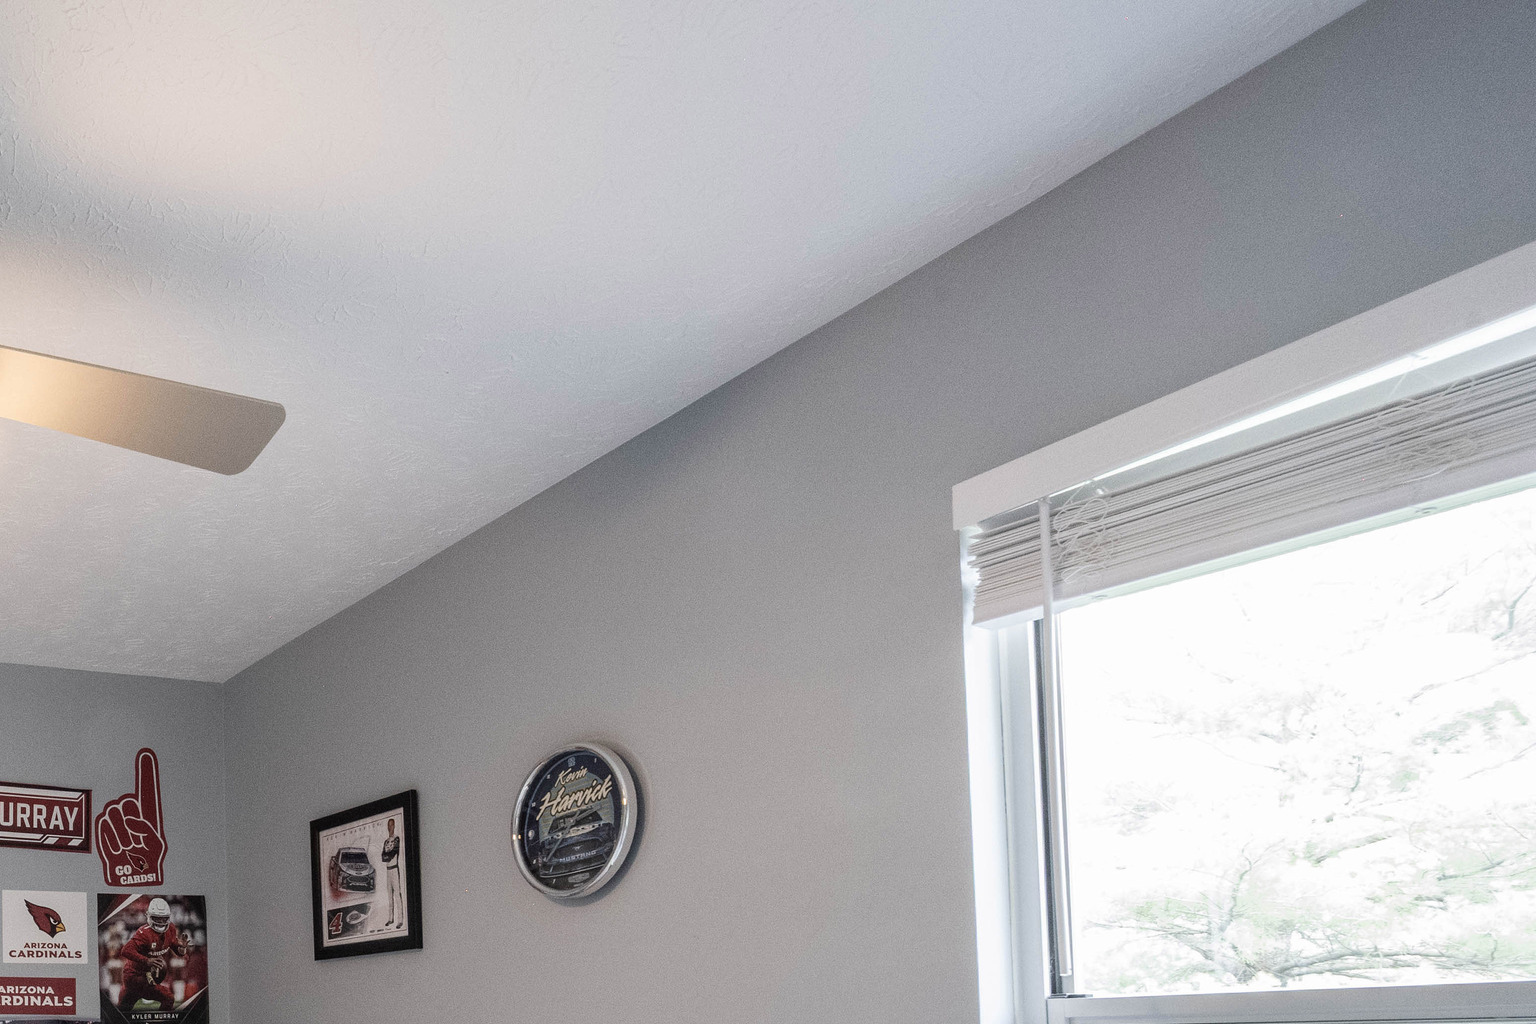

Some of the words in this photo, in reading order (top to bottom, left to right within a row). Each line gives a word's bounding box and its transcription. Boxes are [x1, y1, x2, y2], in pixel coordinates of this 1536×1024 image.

[536, 774, 613, 820] Harvick
[115, 865, 132, 876] GO
[120, 873, 157, 885] CARDS!
[329, 912, 343, 935] 4
[9, 950, 82, 959] CARDINALS
